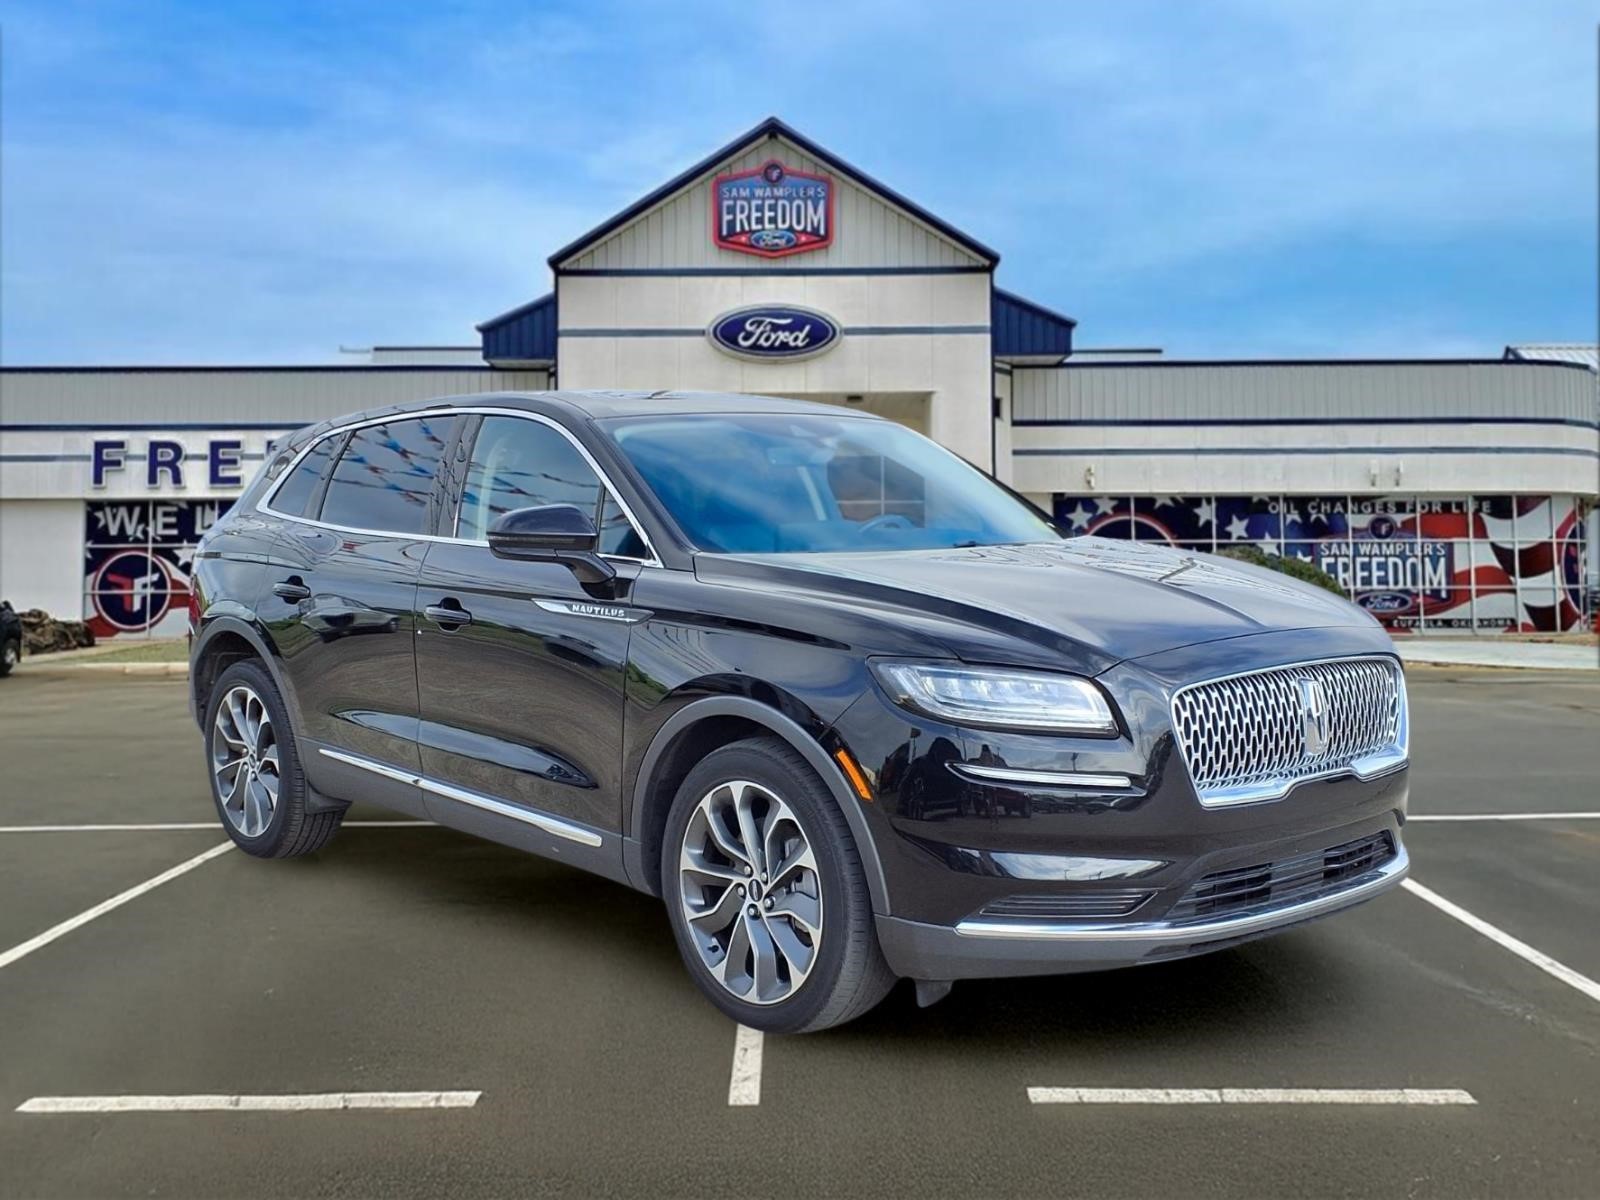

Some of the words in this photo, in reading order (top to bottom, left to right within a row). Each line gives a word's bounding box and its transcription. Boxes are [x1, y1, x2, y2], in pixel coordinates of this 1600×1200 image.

[722, 187, 750, 198] SAM
[722, 200, 825, 236] FREEDOM
[738, 316, 811, 347] Ford
[93, 440, 275, 486] FRE
[1268, 501, 1299, 514] OIL
[1308, 500, 1397, 514] CHANGES
[1406, 501, 1443, 514] FOR
[1453, 501, 1492, 513] LIFE
[1321, 543, 1351, 556] SAM
[1321, 557, 1447, 598] FREEDOM
[1365, 595, 1400, 609] Ford
[572, 604, 625, 618] NAUTILUS
